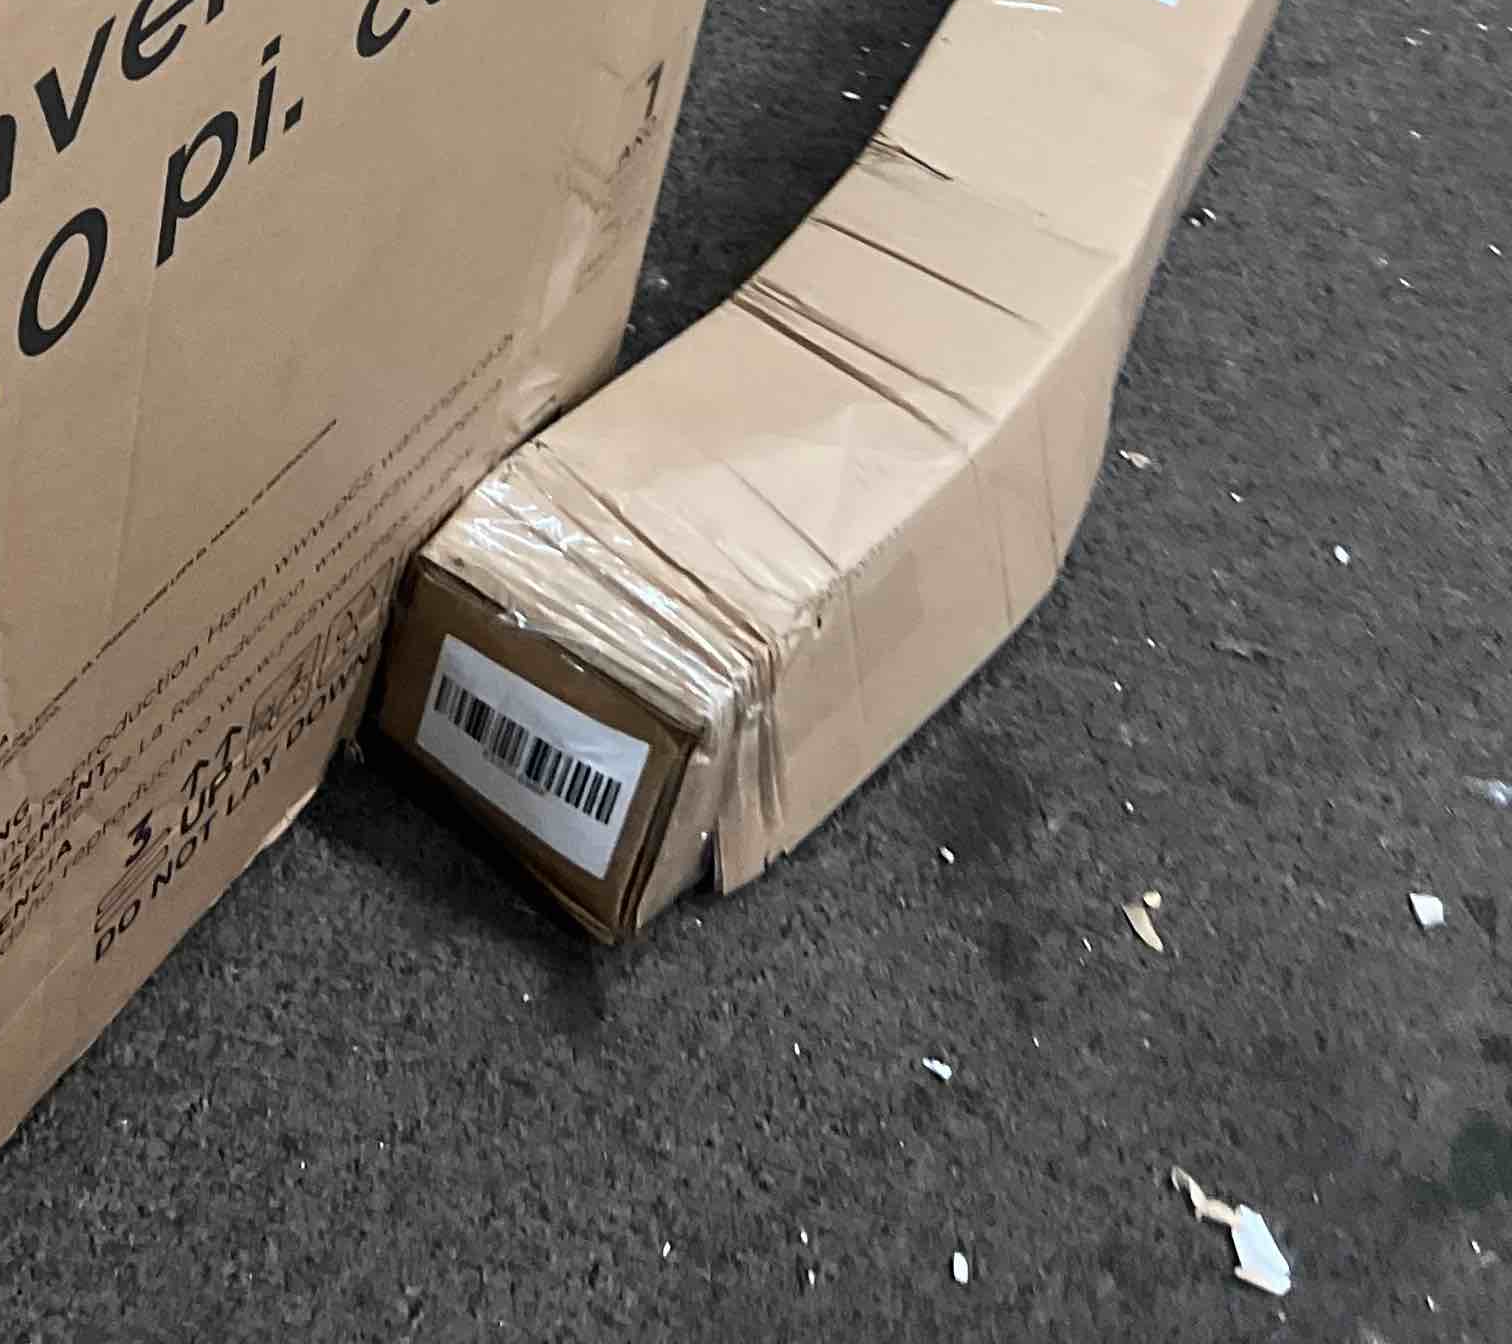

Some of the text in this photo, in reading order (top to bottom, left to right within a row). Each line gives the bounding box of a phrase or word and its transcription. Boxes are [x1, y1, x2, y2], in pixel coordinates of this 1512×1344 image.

[154, 35, 304, 269] pi.
[94, 643, 372, 964] DO NOT LAY DOWN
[181, 761, 233, 835] UP
